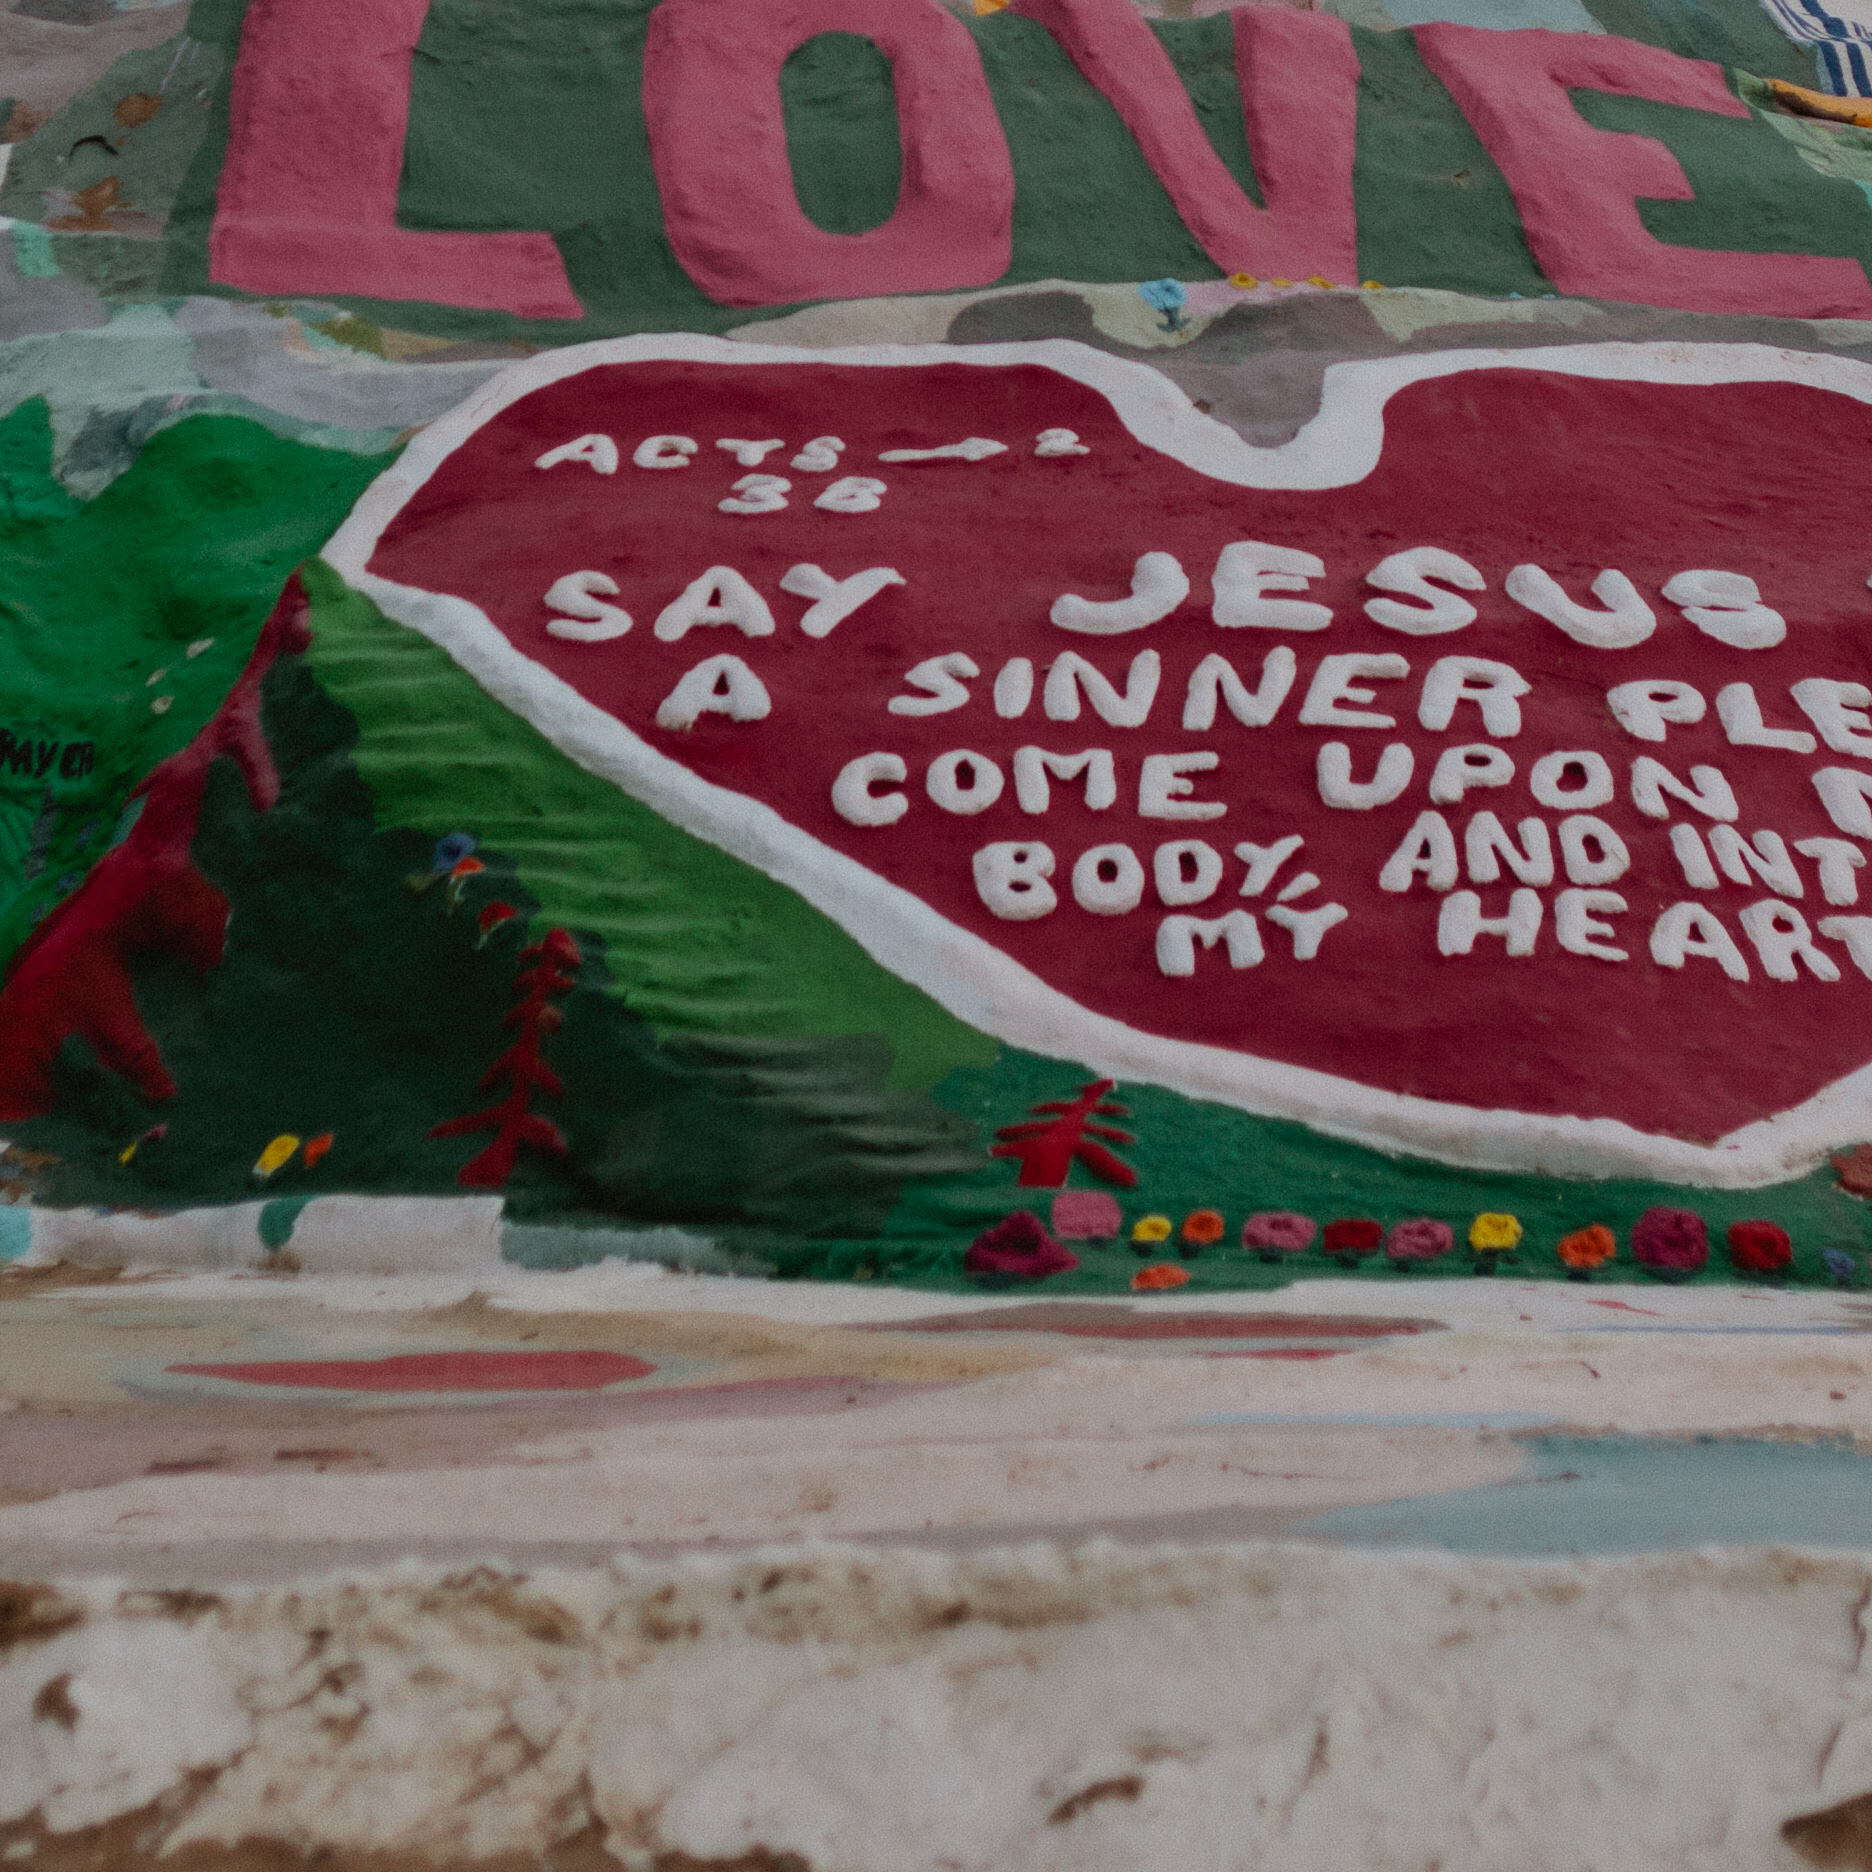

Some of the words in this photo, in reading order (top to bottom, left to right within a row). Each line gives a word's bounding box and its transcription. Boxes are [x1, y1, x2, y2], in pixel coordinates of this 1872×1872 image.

[534, 433, 846, 474] ACTS
[544, 563, 907, 642] SAY
[1050, 540, 1788, 650] JESUS
[656, 653, 772, 730] A
[888, 645, 1532, 737] SINNER
[831, 745, 1228, 827] COME
[1315, 742, 1740, 822] UPON
[1378, 809, 1632, 892] AND
[1156, 902, 1348, 976] MY
